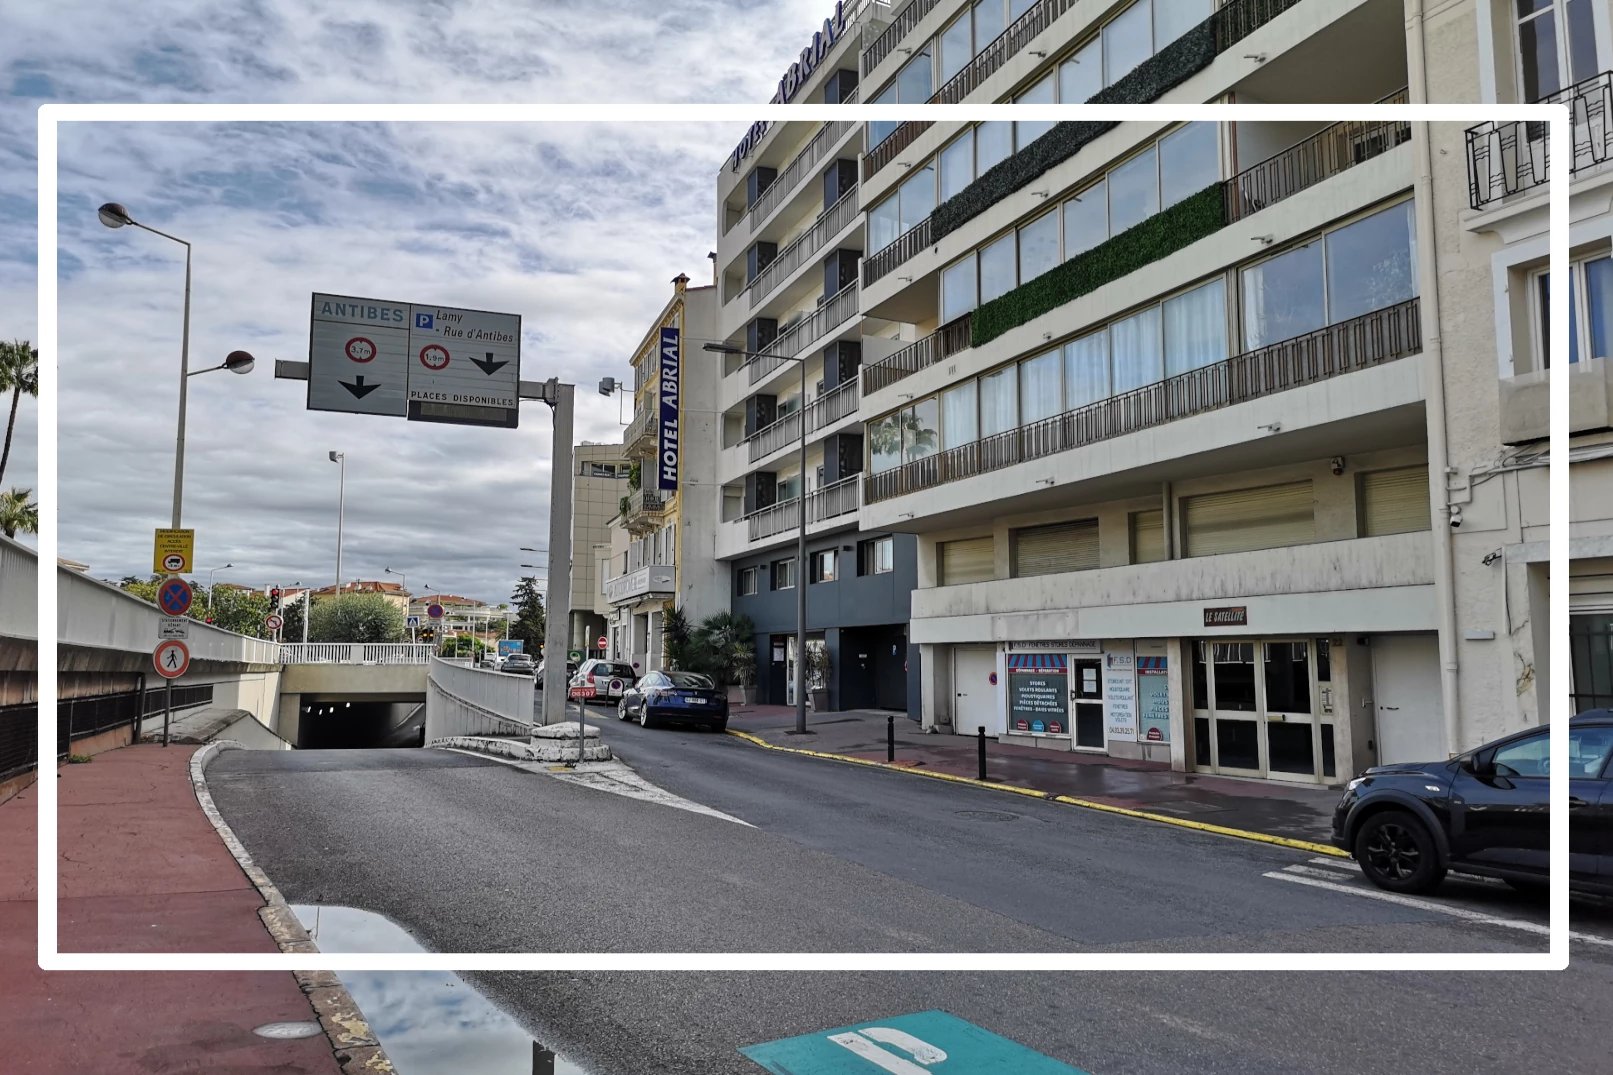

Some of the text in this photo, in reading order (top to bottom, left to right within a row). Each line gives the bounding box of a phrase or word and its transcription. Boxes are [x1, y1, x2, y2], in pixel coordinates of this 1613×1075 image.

[321, 301, 404, 322] ANTIBES
[436, 310, 463, 325] Lamy
[419, 315, 430, 327] P
[443, 325, 463, 338] Rue
[467, 328, 514, 342] d'Antibes
[661, 335, 678, 410] ABRIAL
[411, 391, 447, 400] PLACES
[453, 394, 514, 406] DISPONIBLES
[663, 419, 678, 481] HOTEL
[1205, 610, 1244, 622] LE SATELLITE
